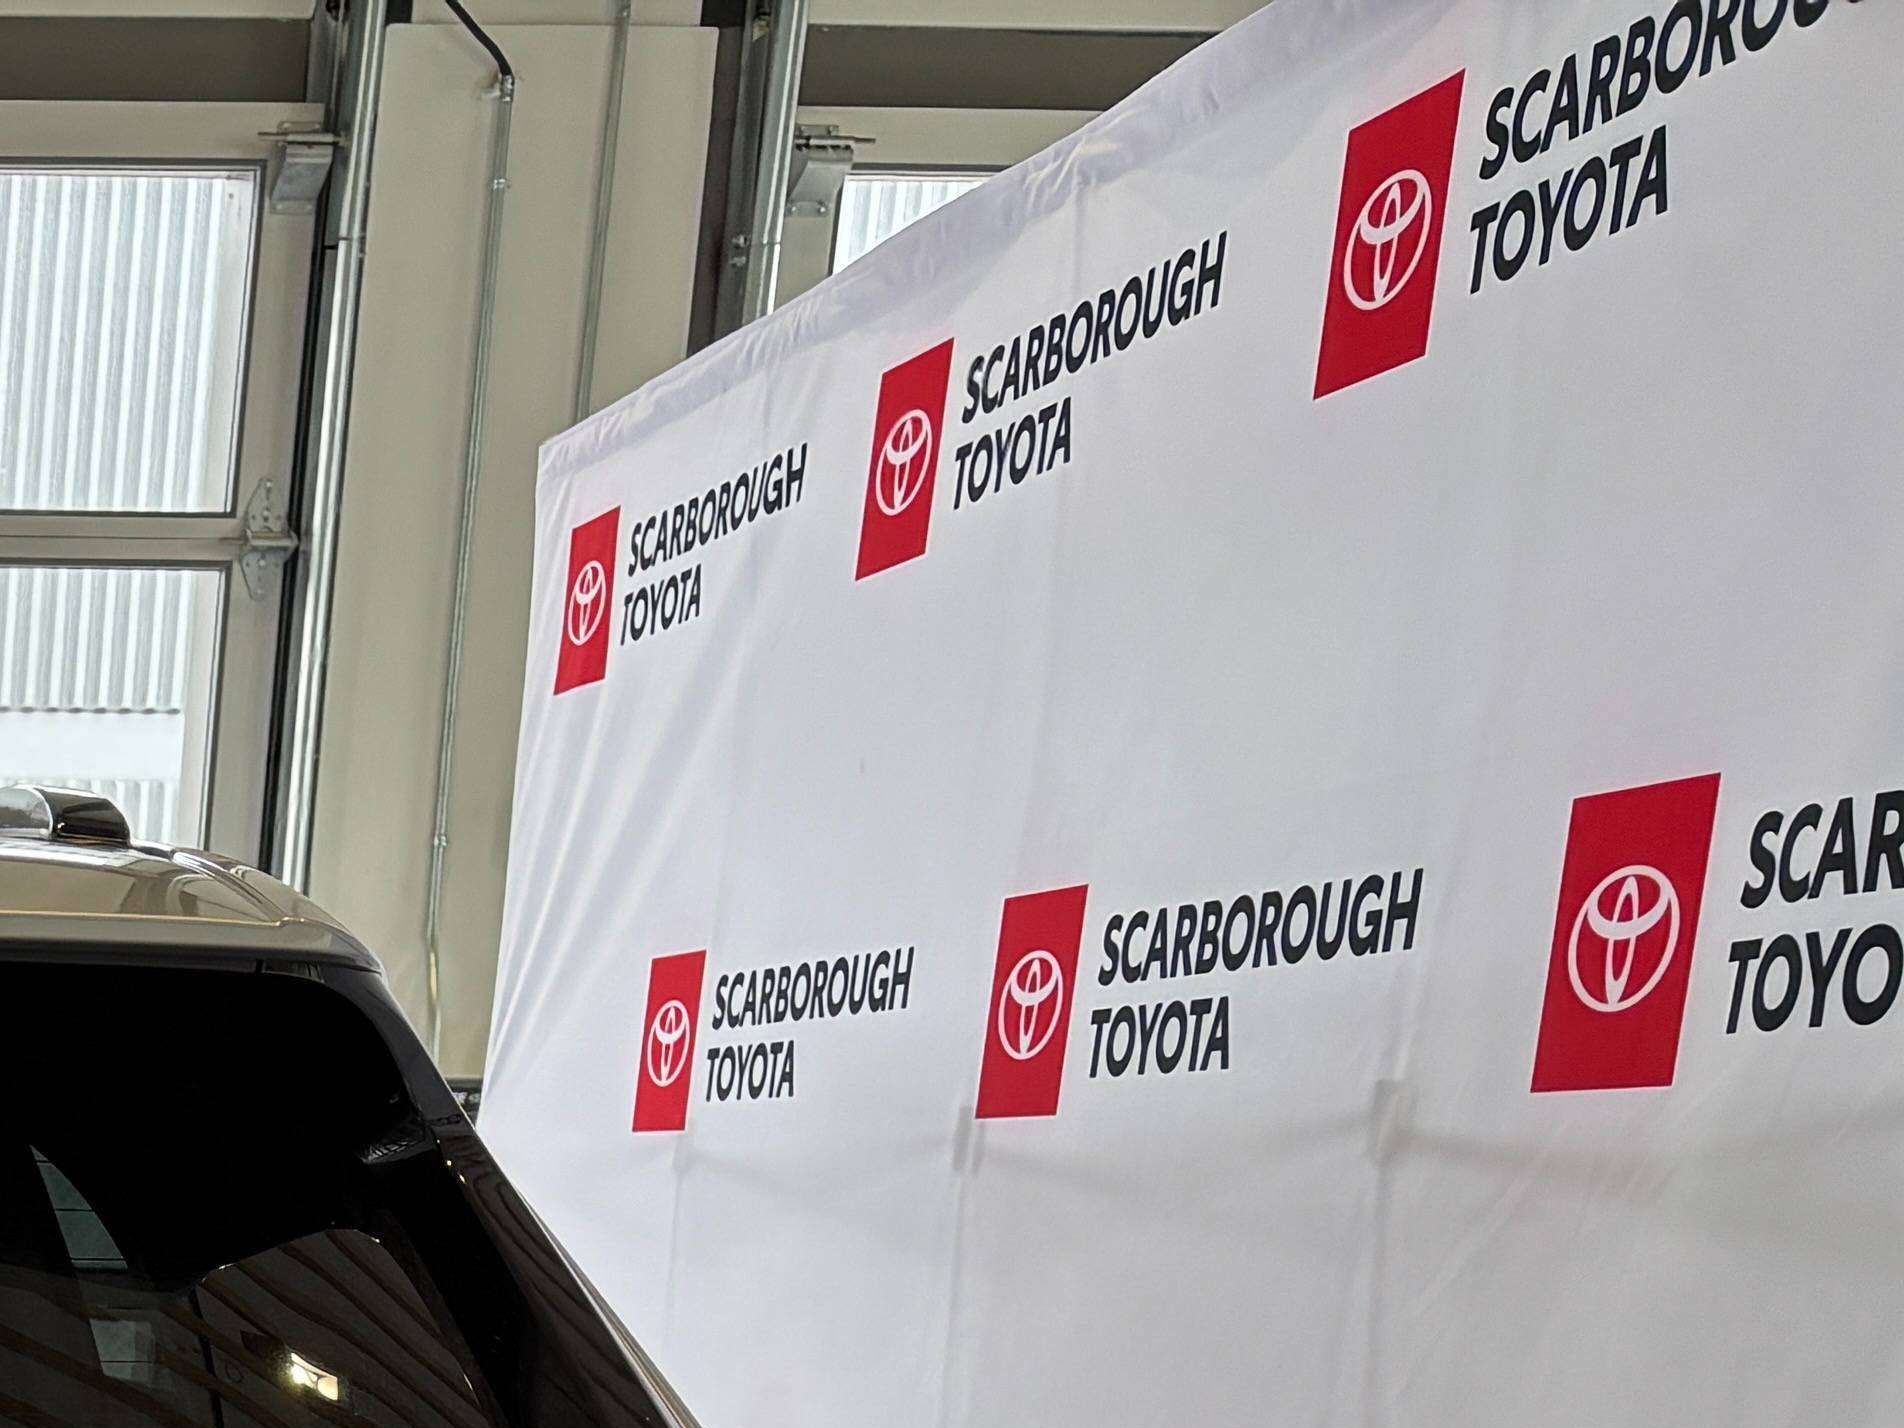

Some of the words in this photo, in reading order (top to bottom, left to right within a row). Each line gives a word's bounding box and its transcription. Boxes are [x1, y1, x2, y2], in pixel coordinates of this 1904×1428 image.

[1478, 0, 1859, 180] SCARBORO
[1469, 124, 1668, 295] TOYOTA
[961, 230, 1228, 424] SCARBOROUGH
[627, 442, 808, 577] SCARBOROUGH
[953, 396, 1072, 511] TOYOTA
[620, 563, 702, 646] TOYOTA
[1097, 867, 1424, 987] SCARBOROUGH
[1725, 923, 1904, 1035] TOYO
[711, 946, 915, 1031] SCARBOROUGH
[1089, 995, 1230, 1079] TOYOTA
[705, 1039, 795, 1102] TOYOTA
